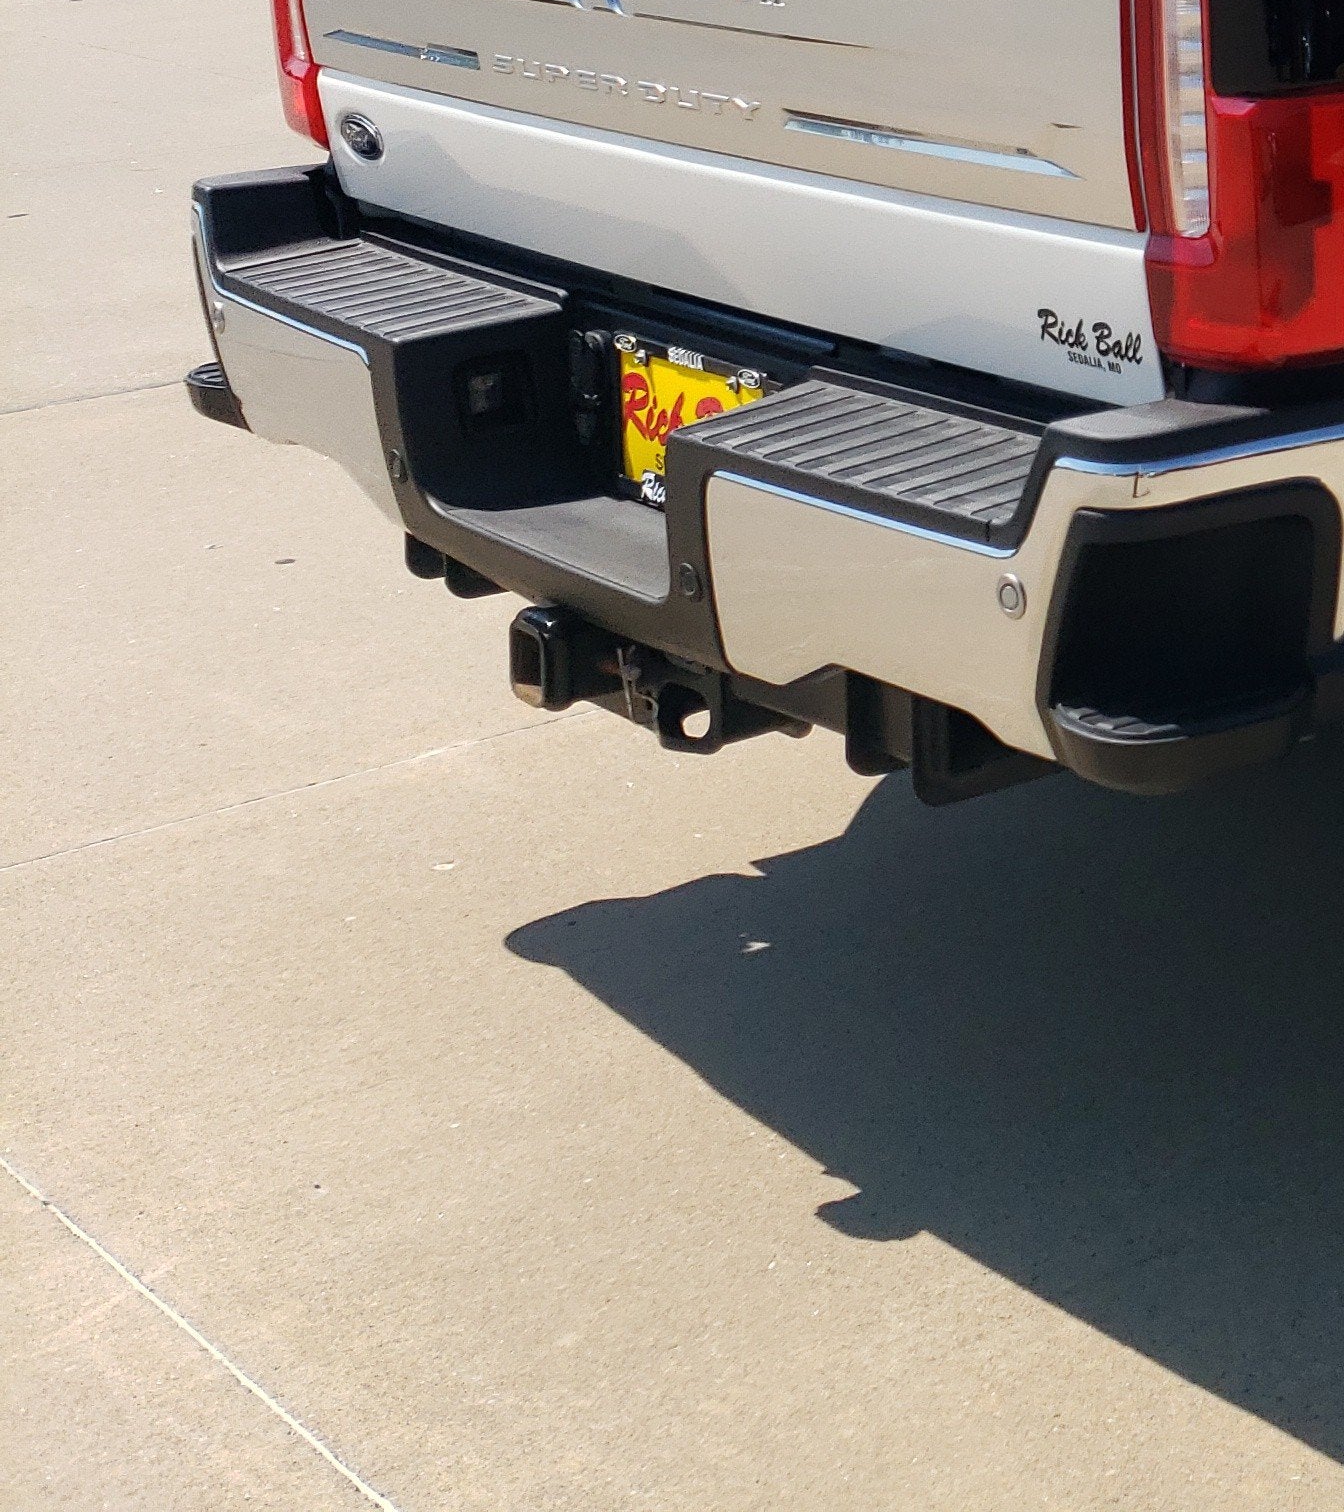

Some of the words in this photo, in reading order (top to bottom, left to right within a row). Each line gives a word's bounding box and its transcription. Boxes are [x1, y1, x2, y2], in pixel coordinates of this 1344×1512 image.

[492, 53, 629, 97] SUPER
[637, 80, 763, 122] DUTY
[1037, 308, 1089, 352] Rick
[1091, 321, 1144, 365] Ball
[1067, 350, 1107, 373] SEDALIA,
[1107, 360, 1122, 375] MO
